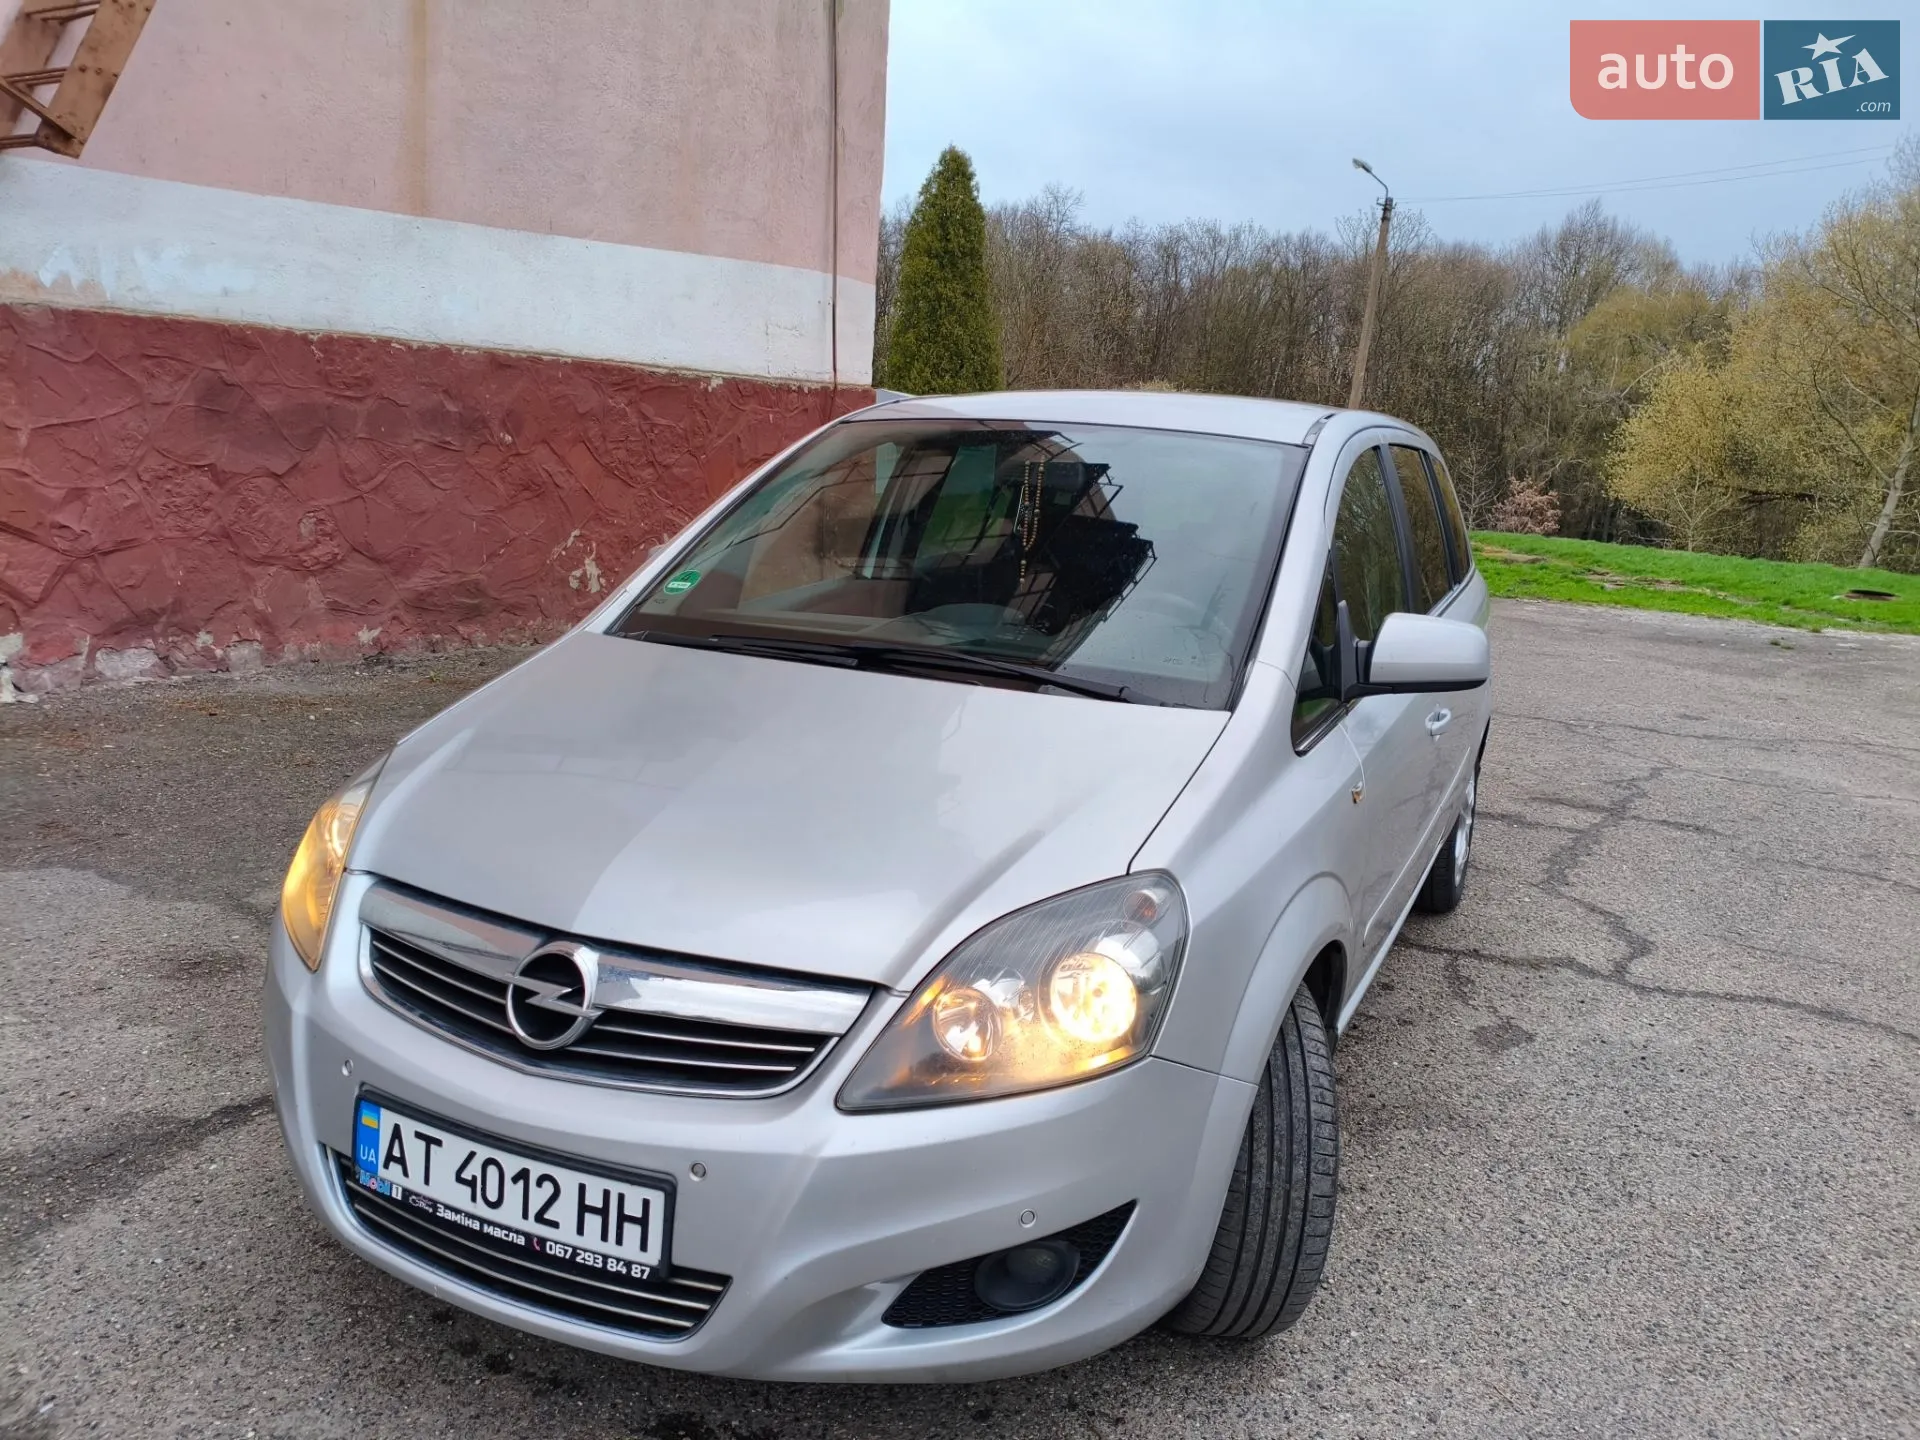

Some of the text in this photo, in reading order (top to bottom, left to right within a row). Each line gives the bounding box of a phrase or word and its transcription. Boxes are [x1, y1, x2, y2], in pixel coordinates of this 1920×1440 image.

[360, 1143, 377, 1165] UA
[382, 1122, 650, 1252] AT 4012 HH
[436, 1203, 480, 1231] Заміна
[483, 1223, 525, 1246] масла
[546, 1241, 573, 1260] 067
[576, 1250, 603, 1269] 293
[606, 1257, 627, 1274] 84
[630, 1263, 651, 1281] 87
